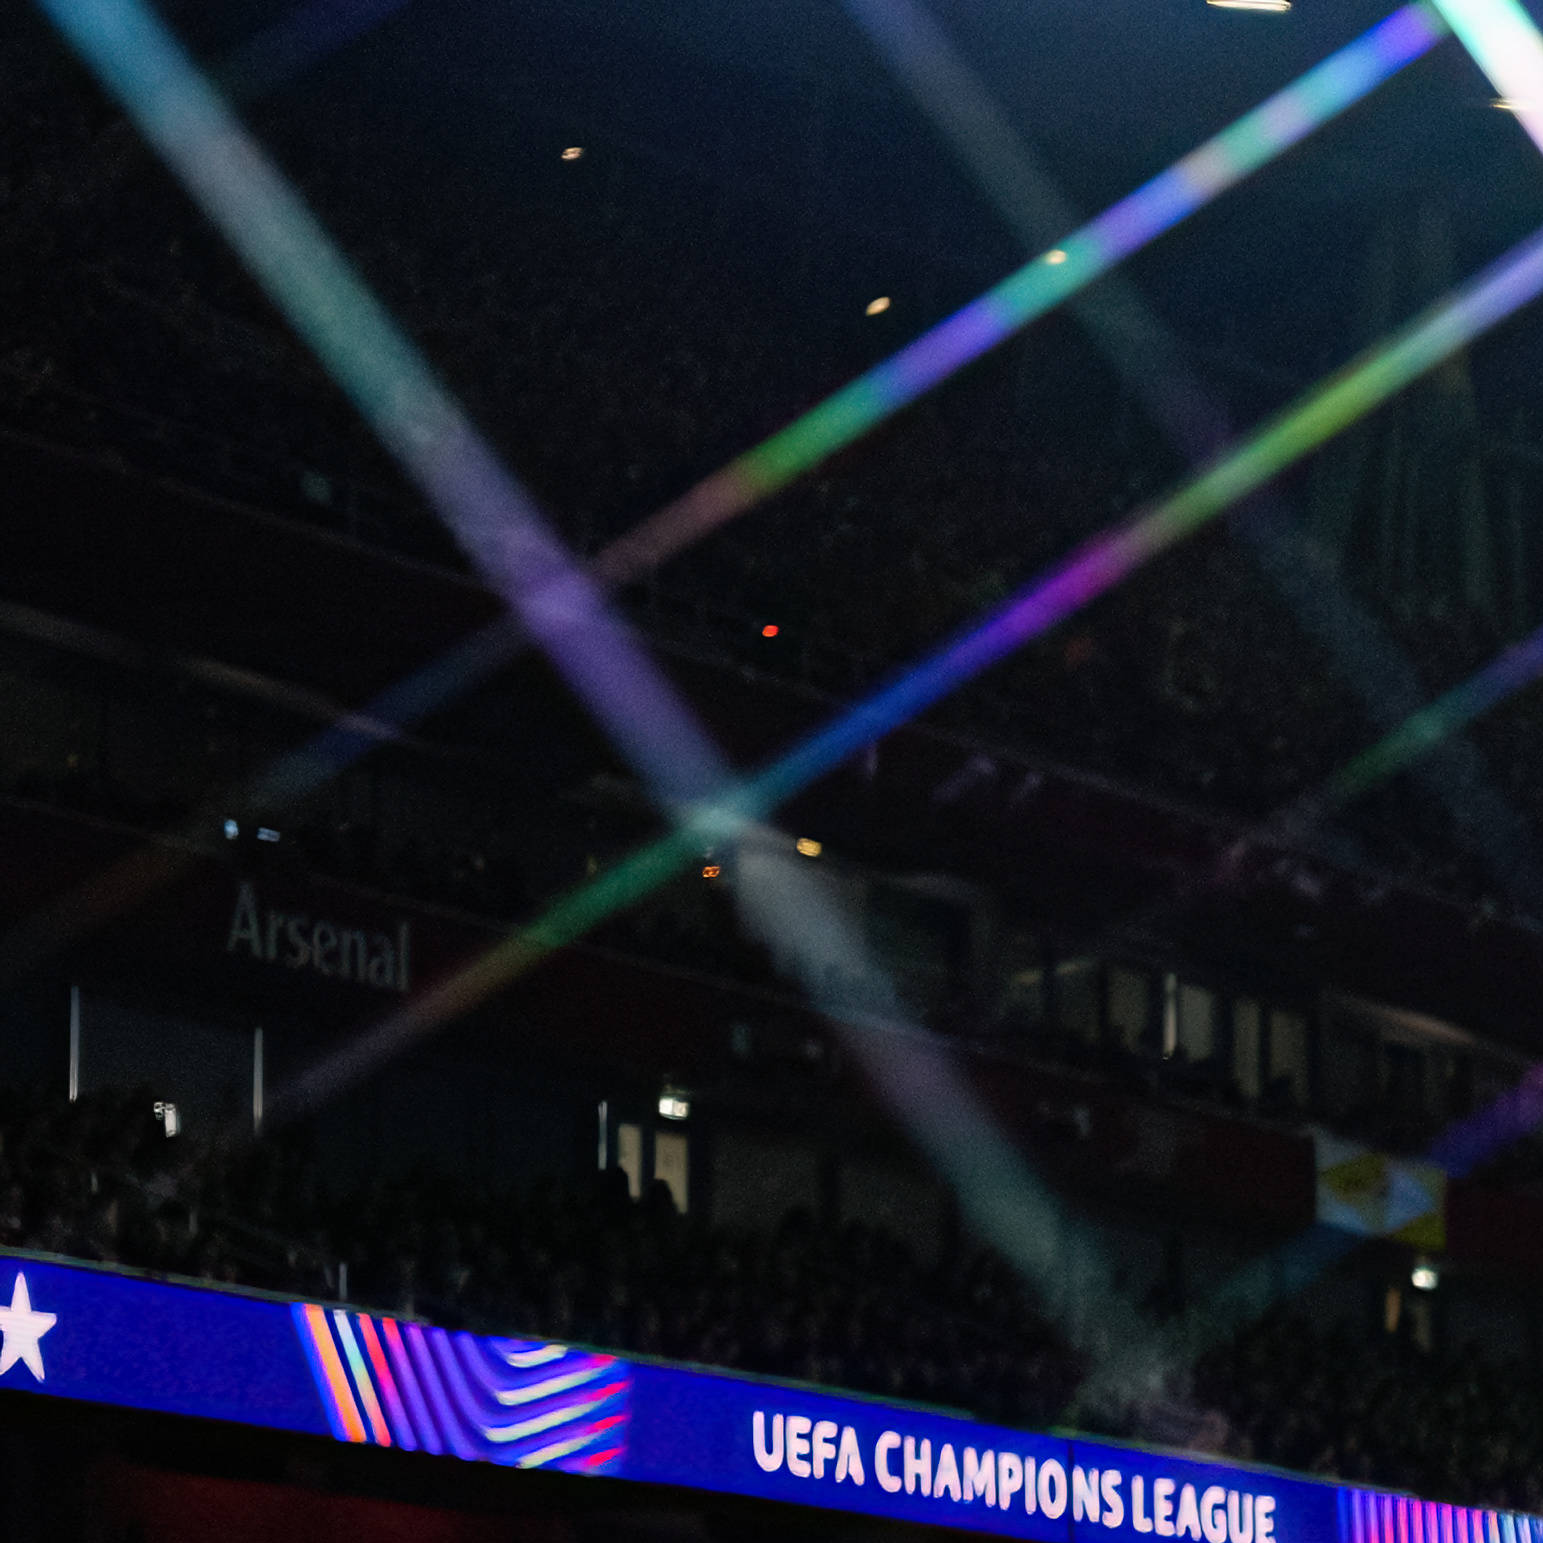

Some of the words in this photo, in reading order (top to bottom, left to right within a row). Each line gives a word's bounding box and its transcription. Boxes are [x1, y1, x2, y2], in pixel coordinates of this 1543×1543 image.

[226, 880, 412, 993] Arsenal
[753, 1411, 865, 1486] UEFA
[874, 1430, 1124, 1529] CHAMPIONS
